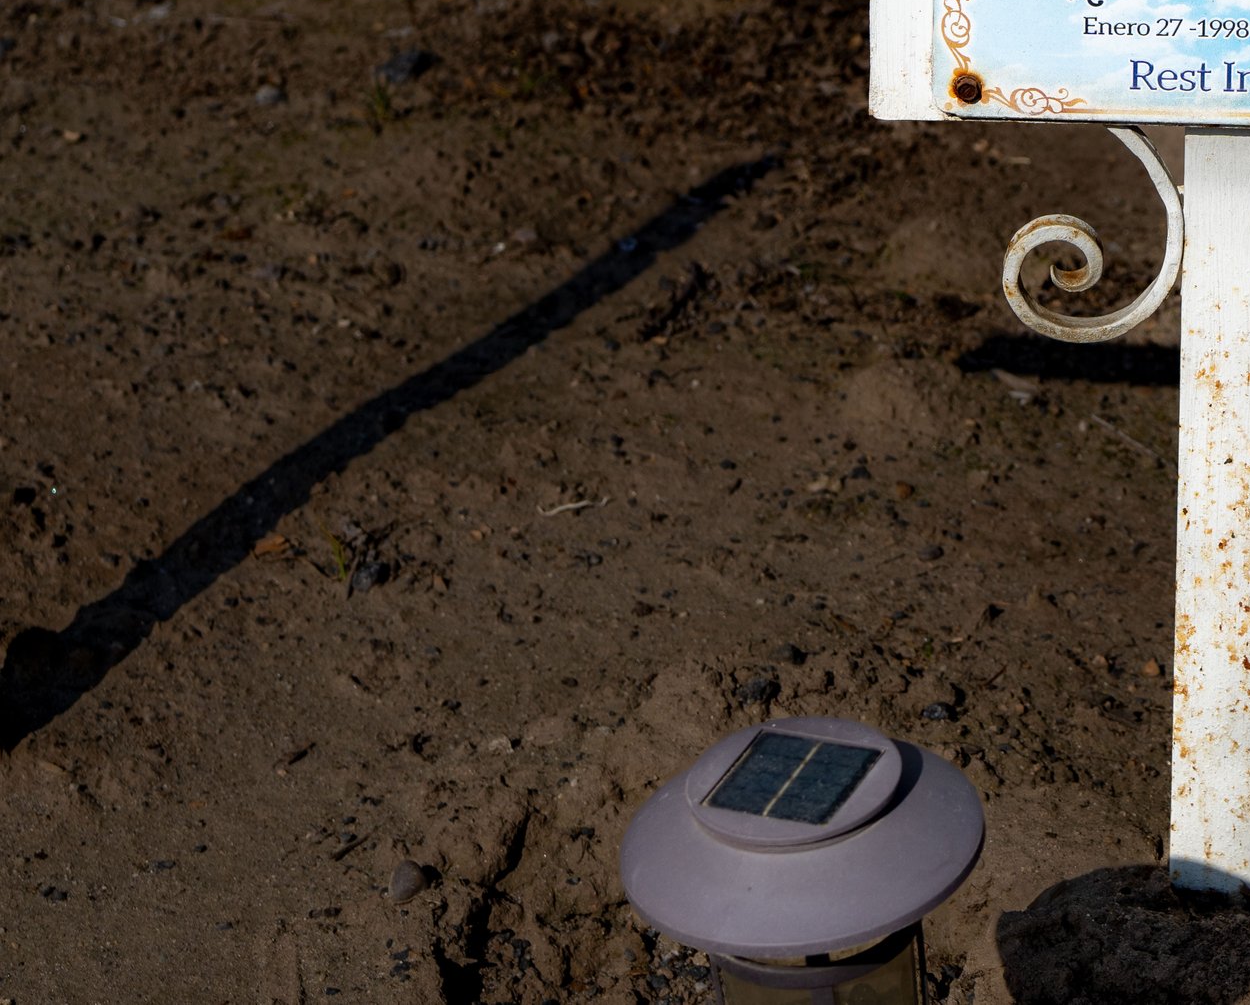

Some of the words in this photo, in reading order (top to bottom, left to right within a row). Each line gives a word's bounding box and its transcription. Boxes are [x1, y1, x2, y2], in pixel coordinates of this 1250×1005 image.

[1083, 16, 1150, 36] Enero
[1155, 18, 1184, 37] 27
[1129, 59, 1212, 92] Rest
